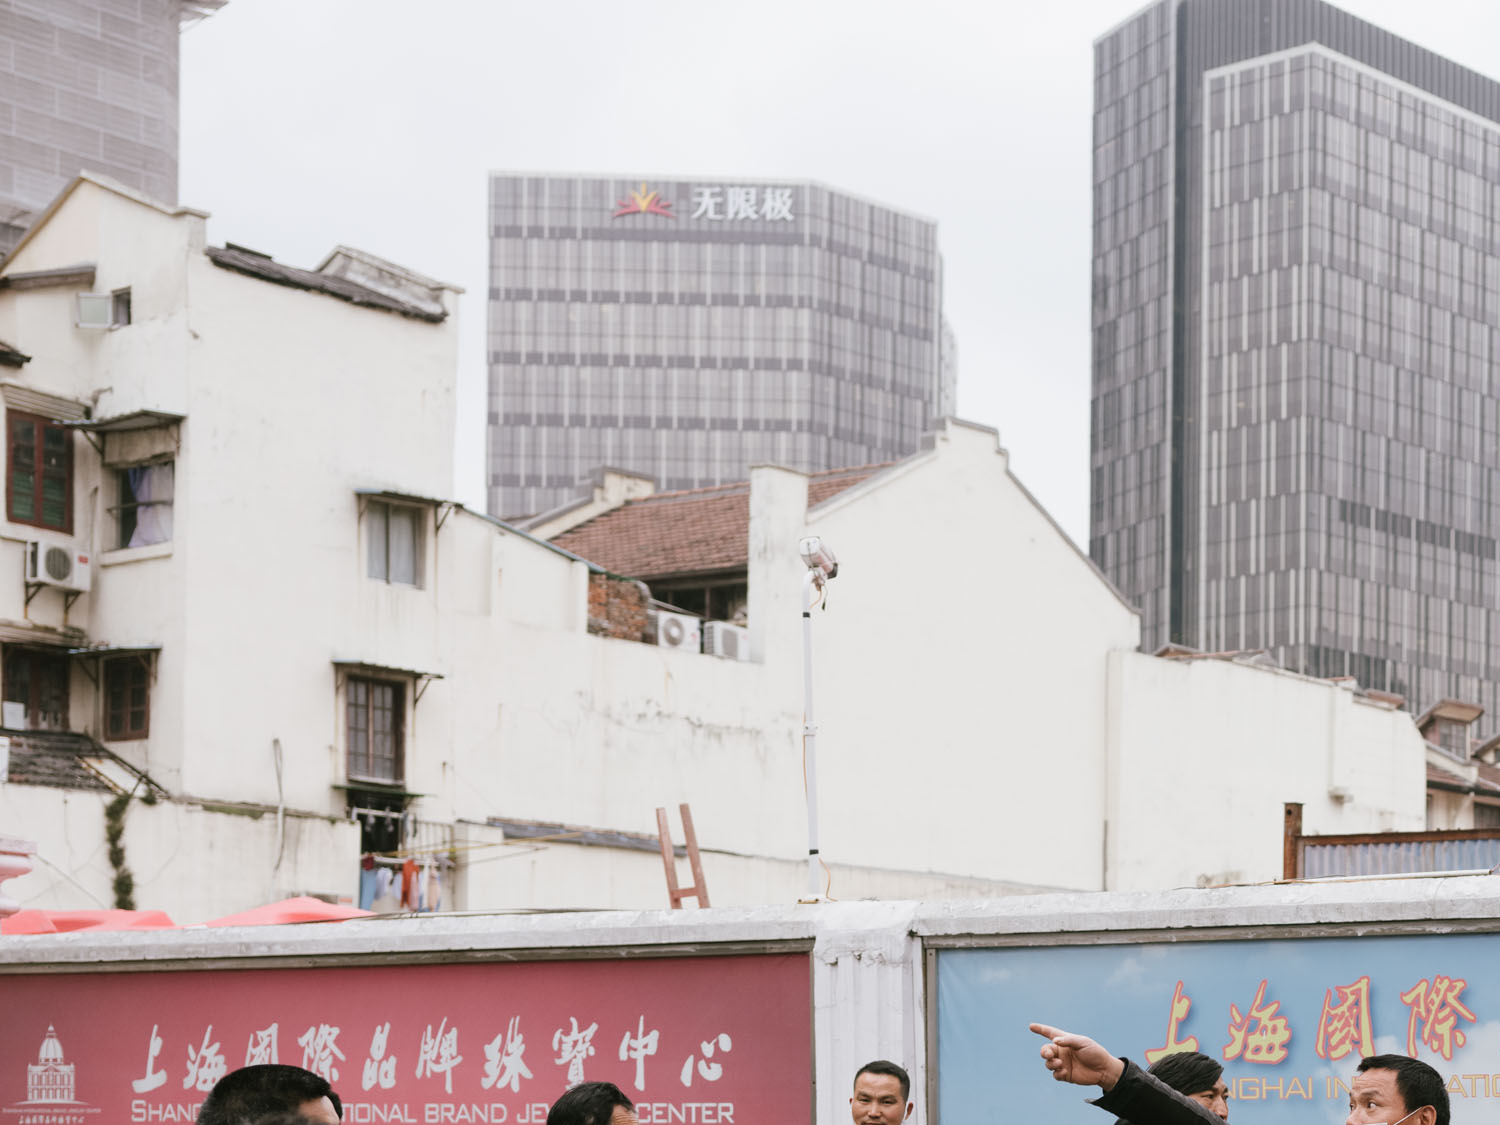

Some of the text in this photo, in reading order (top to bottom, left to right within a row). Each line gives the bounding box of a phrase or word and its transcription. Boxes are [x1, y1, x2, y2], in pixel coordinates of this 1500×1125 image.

[692, 186, 796, 222] 无限极
[425, 1103, 508, 1123] BRAND
